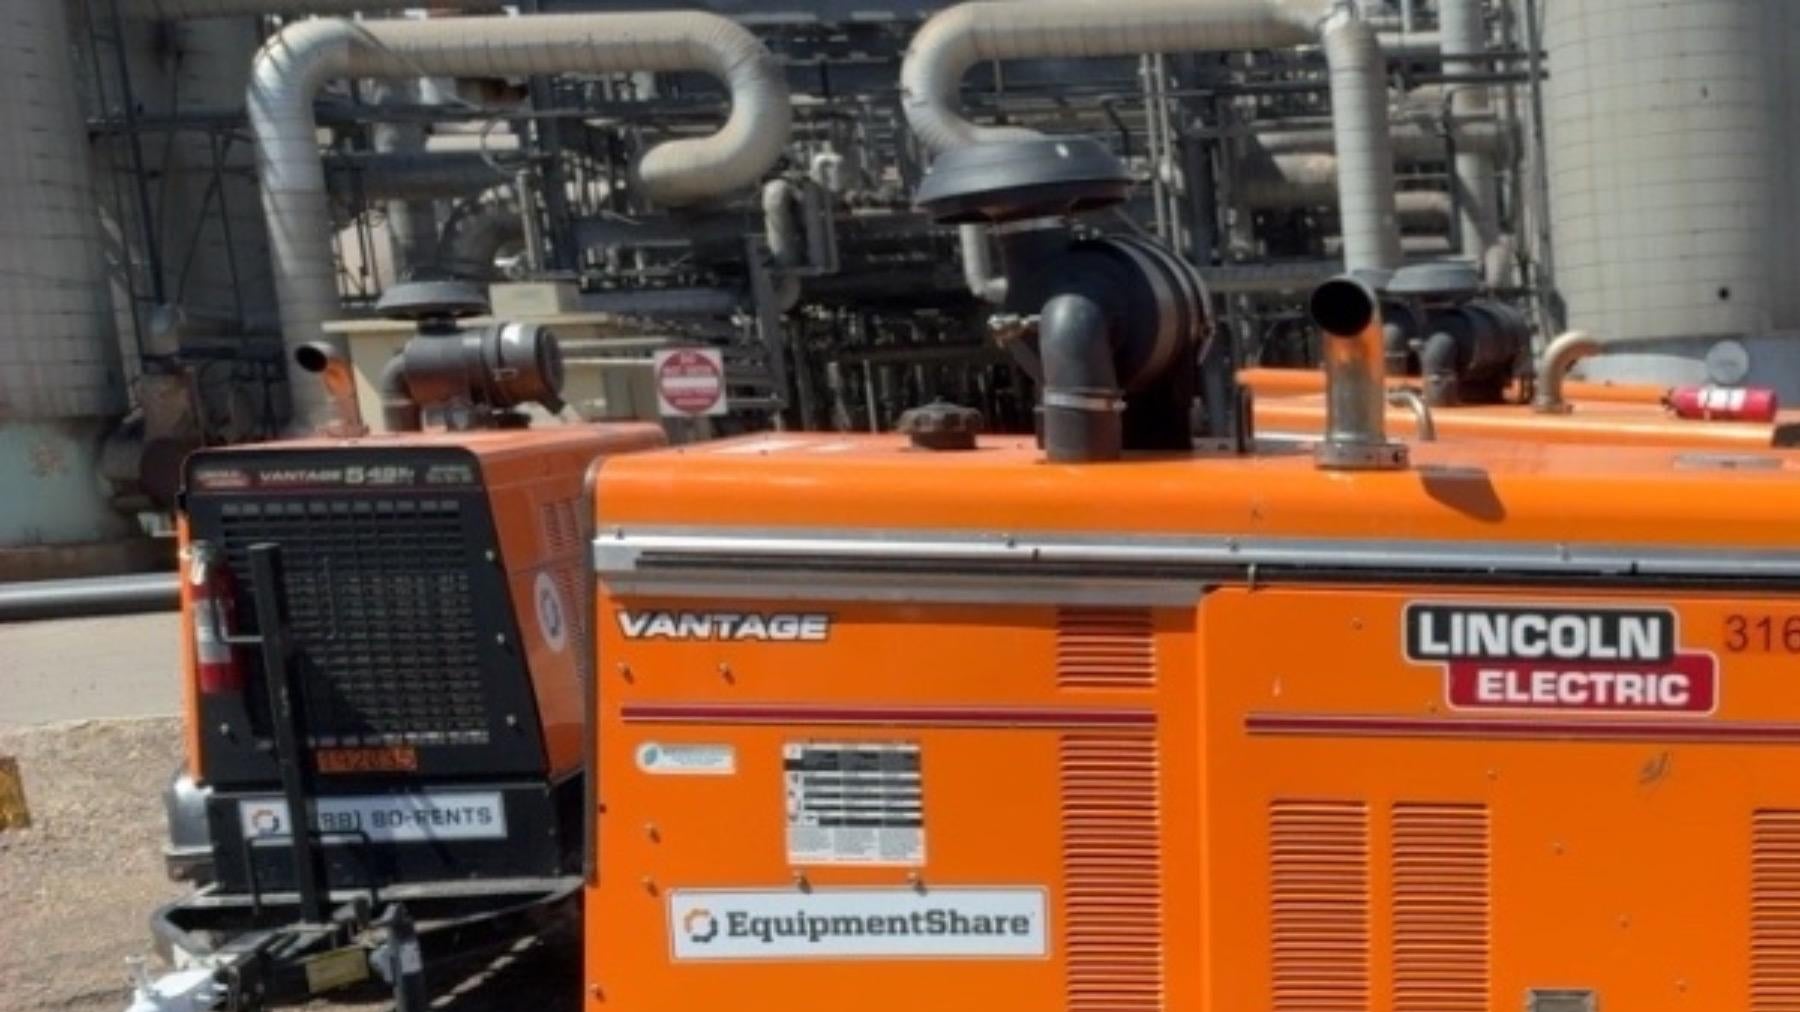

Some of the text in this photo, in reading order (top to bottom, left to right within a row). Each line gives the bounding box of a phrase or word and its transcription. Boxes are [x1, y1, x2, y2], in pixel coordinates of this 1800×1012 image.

[617, 611, 830, 640] VANTAGE
[1418, 612, 1661, 660] LINCOLN
[1476, 669, 1691, 705] ELECTRIC
[726, 909, 1031, 942] EquipmentShare
